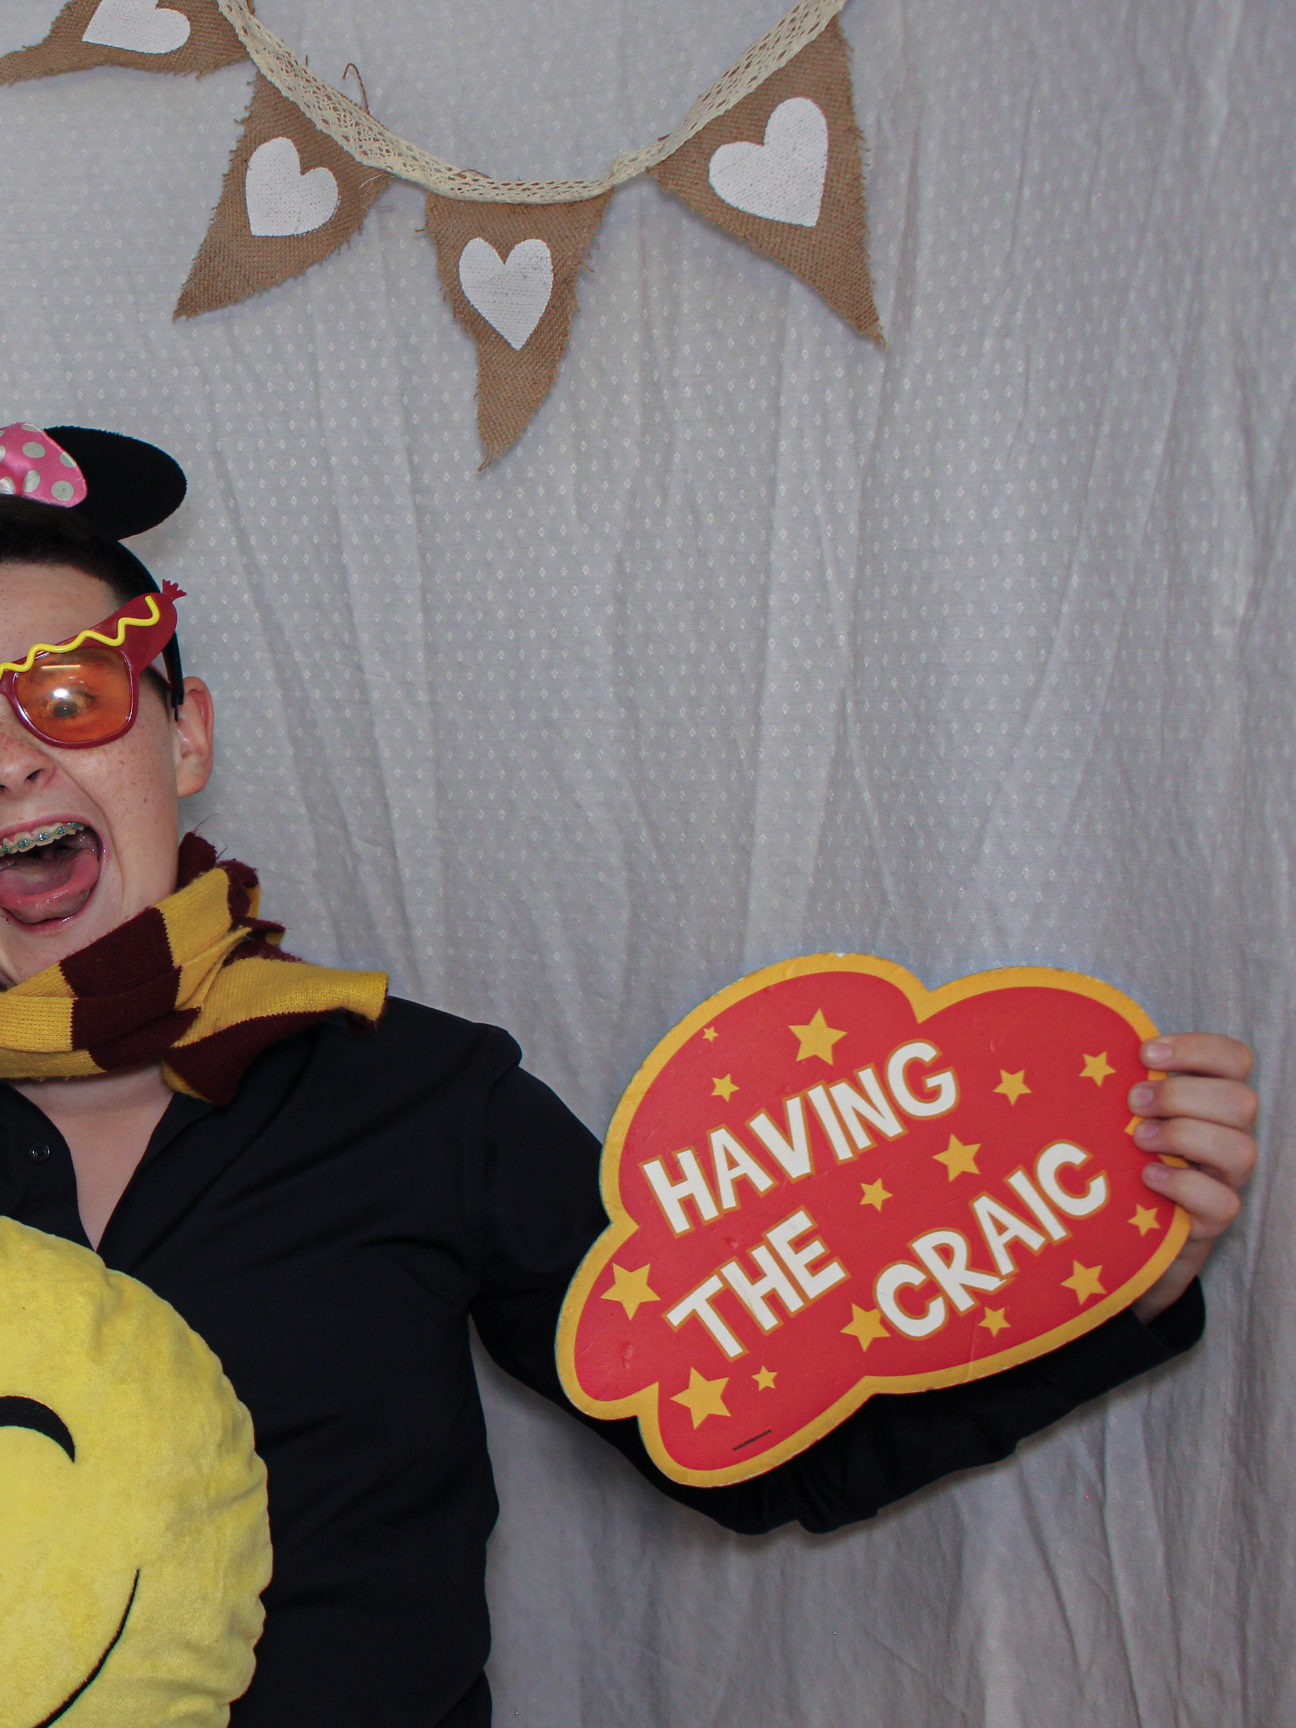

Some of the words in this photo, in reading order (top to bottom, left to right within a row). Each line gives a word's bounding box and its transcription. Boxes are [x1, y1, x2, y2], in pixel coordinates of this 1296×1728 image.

[642, 1041, 958, 1234] HAVING
[665, 1209, 846, 1358] THE
[874, 1142, 1108, 1338] CRAIC
